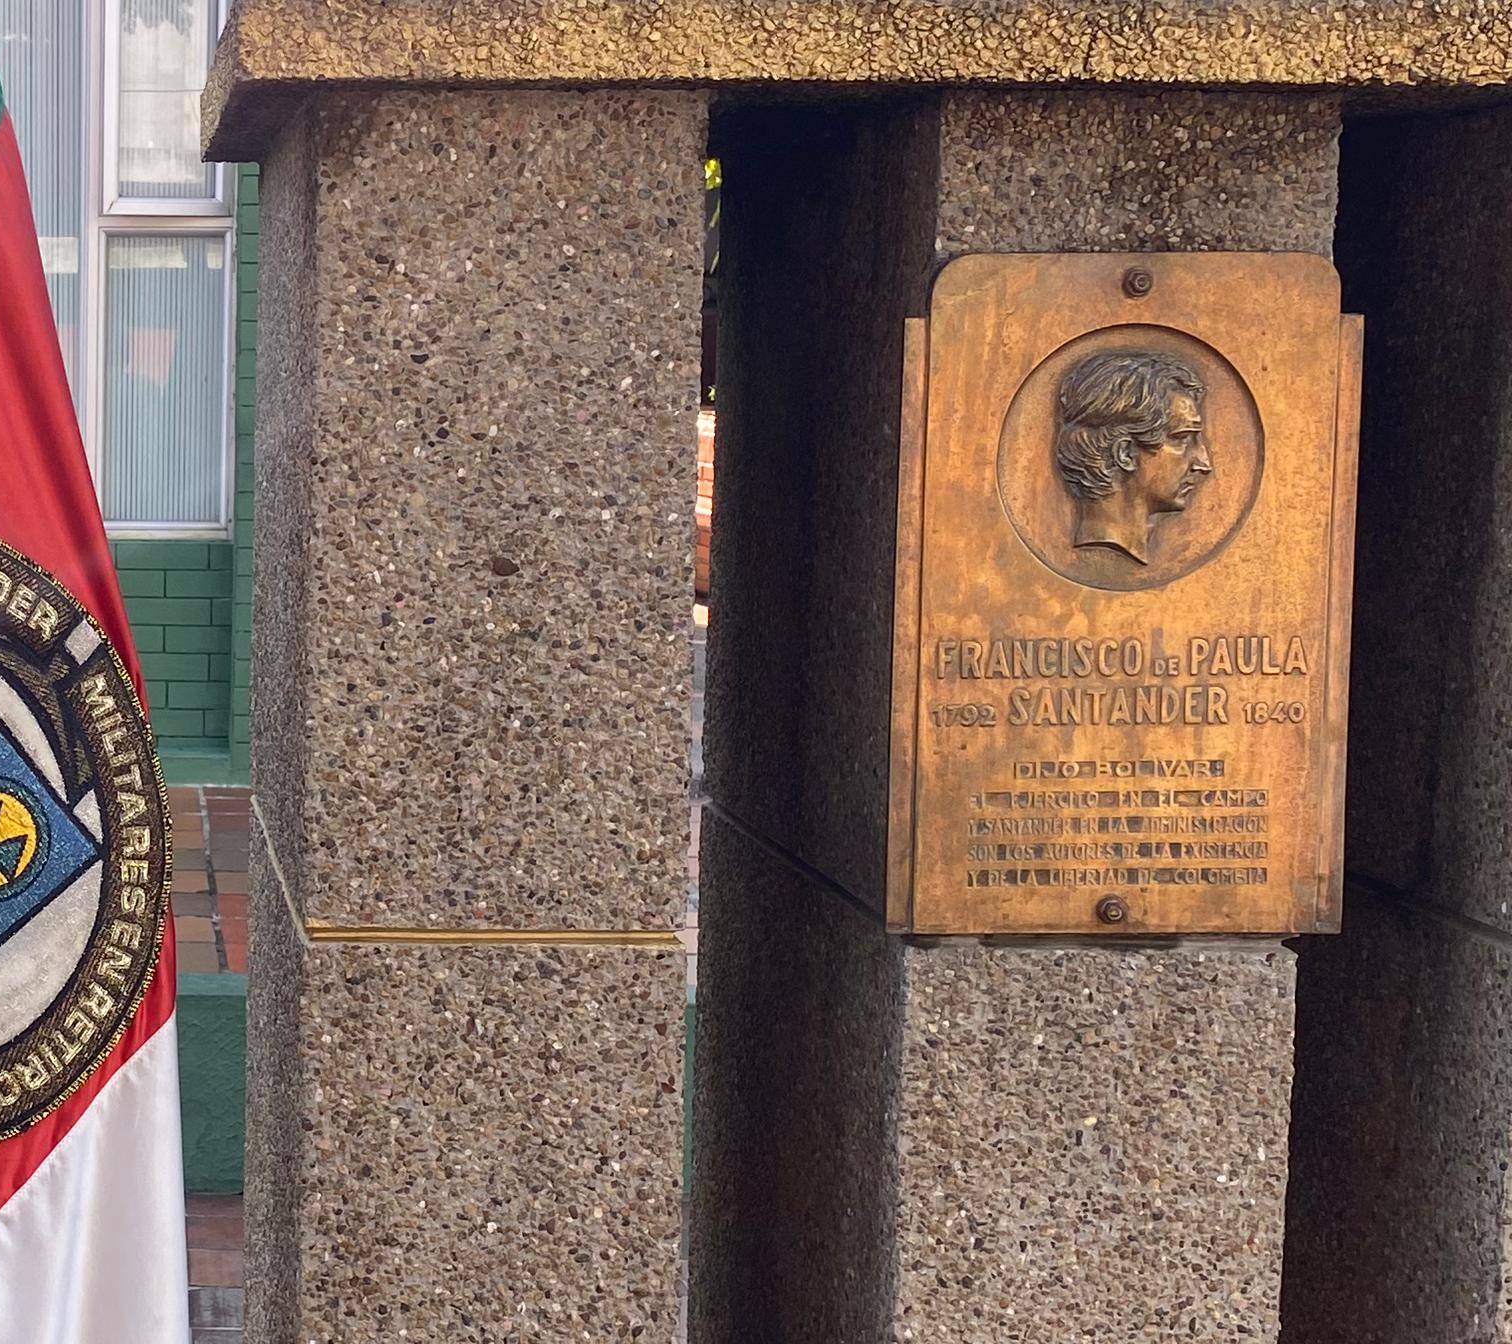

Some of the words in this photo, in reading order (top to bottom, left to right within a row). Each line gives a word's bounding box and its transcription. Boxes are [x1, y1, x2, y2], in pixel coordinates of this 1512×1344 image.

[936, 637, 1144, 679] FRANCISCO
[1152, 658, 1179, 677] DE
[1189, 636, 1309, 676] PAULA
[931, 702, 997, 728] 1792
[1007, 685, 1230, 726] SANTANDER
[1242, 701, 1306, 725] 1840
[1015, 761, 1081, 779] DIJO
[80, 672, 153, 917] MILITARES
[1011, 791, 1100, 809] EJERCITO
[1119, 790, 1142, 807] EN
[1159, 790, 1181, 807] EL
[1199, 789, 1268, 807] CAMPO
[983, 817, 1073, 835] SANTANDER
[1080, 817, 1099, 834] EN
[1108, 817, 1129, 834] LA
[967, 843, 998, 861] SON
[1005, 843, 1035, 860] LOS
[1043, 843, 1116, 860] AUTORES
[1121, 842, 1140, 859] DE
[1151, 842, 1173, 859] LA
[1180, 841, 1268, 859] EXISTENCIA
[968, 869, 982, 887] Y
[988, 869, 1010, 886] DE
[1017, 868, 1040, 886] LA
[1049, 868, 1129, 886] LIBERTAD
[1137, 867, 1159, 885] DE
[1173, 867, 1268, 885] COLOMBIA
[96, 918, 144, 982] EN
